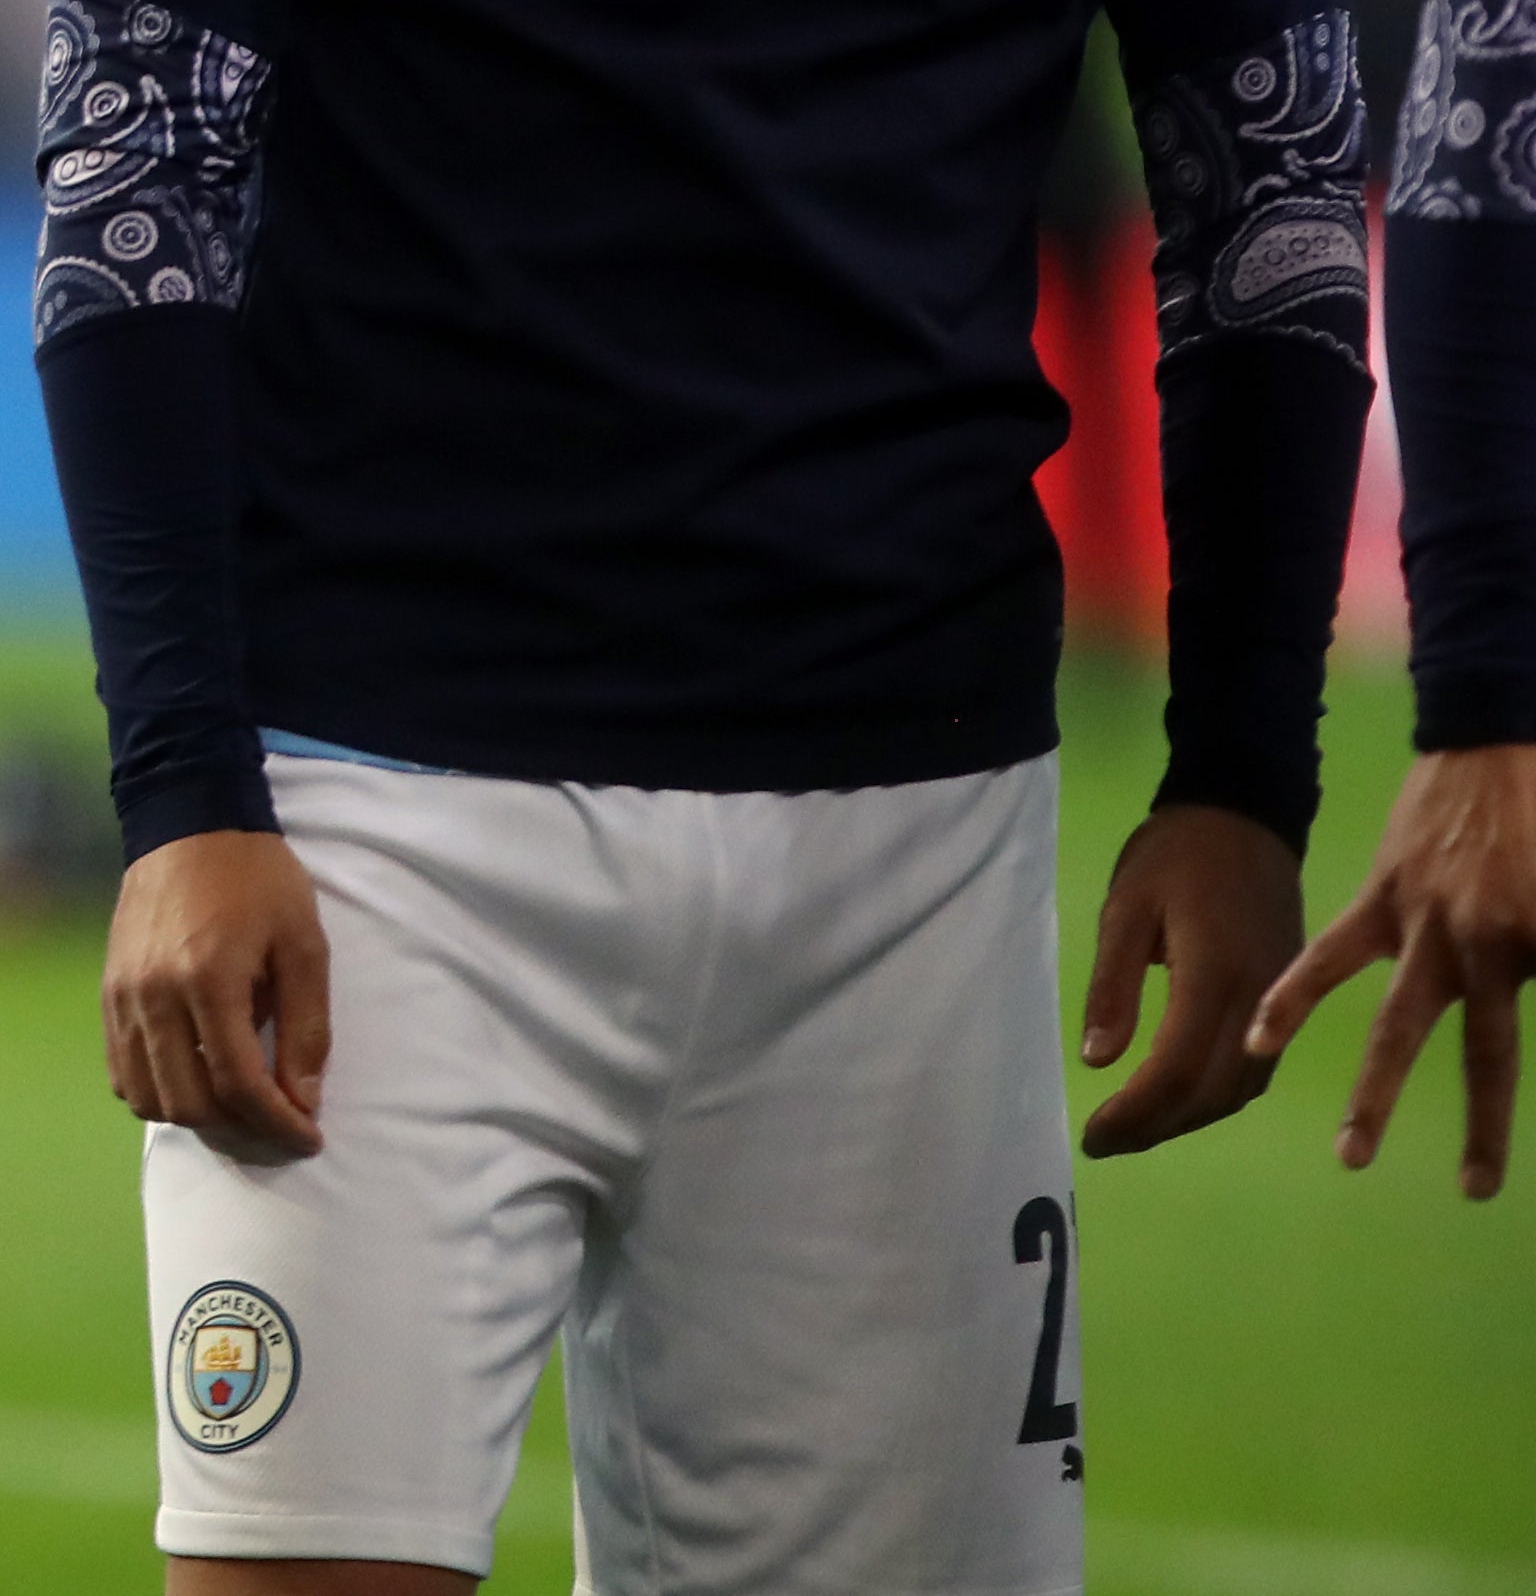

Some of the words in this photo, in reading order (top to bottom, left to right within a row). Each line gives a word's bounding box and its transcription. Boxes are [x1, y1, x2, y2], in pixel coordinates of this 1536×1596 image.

[178, 1294, 284, 1347] MANCHESTER
[1012, 1190, 1078, 1445] 2
[200, 1423, 241, 1440] CITY
